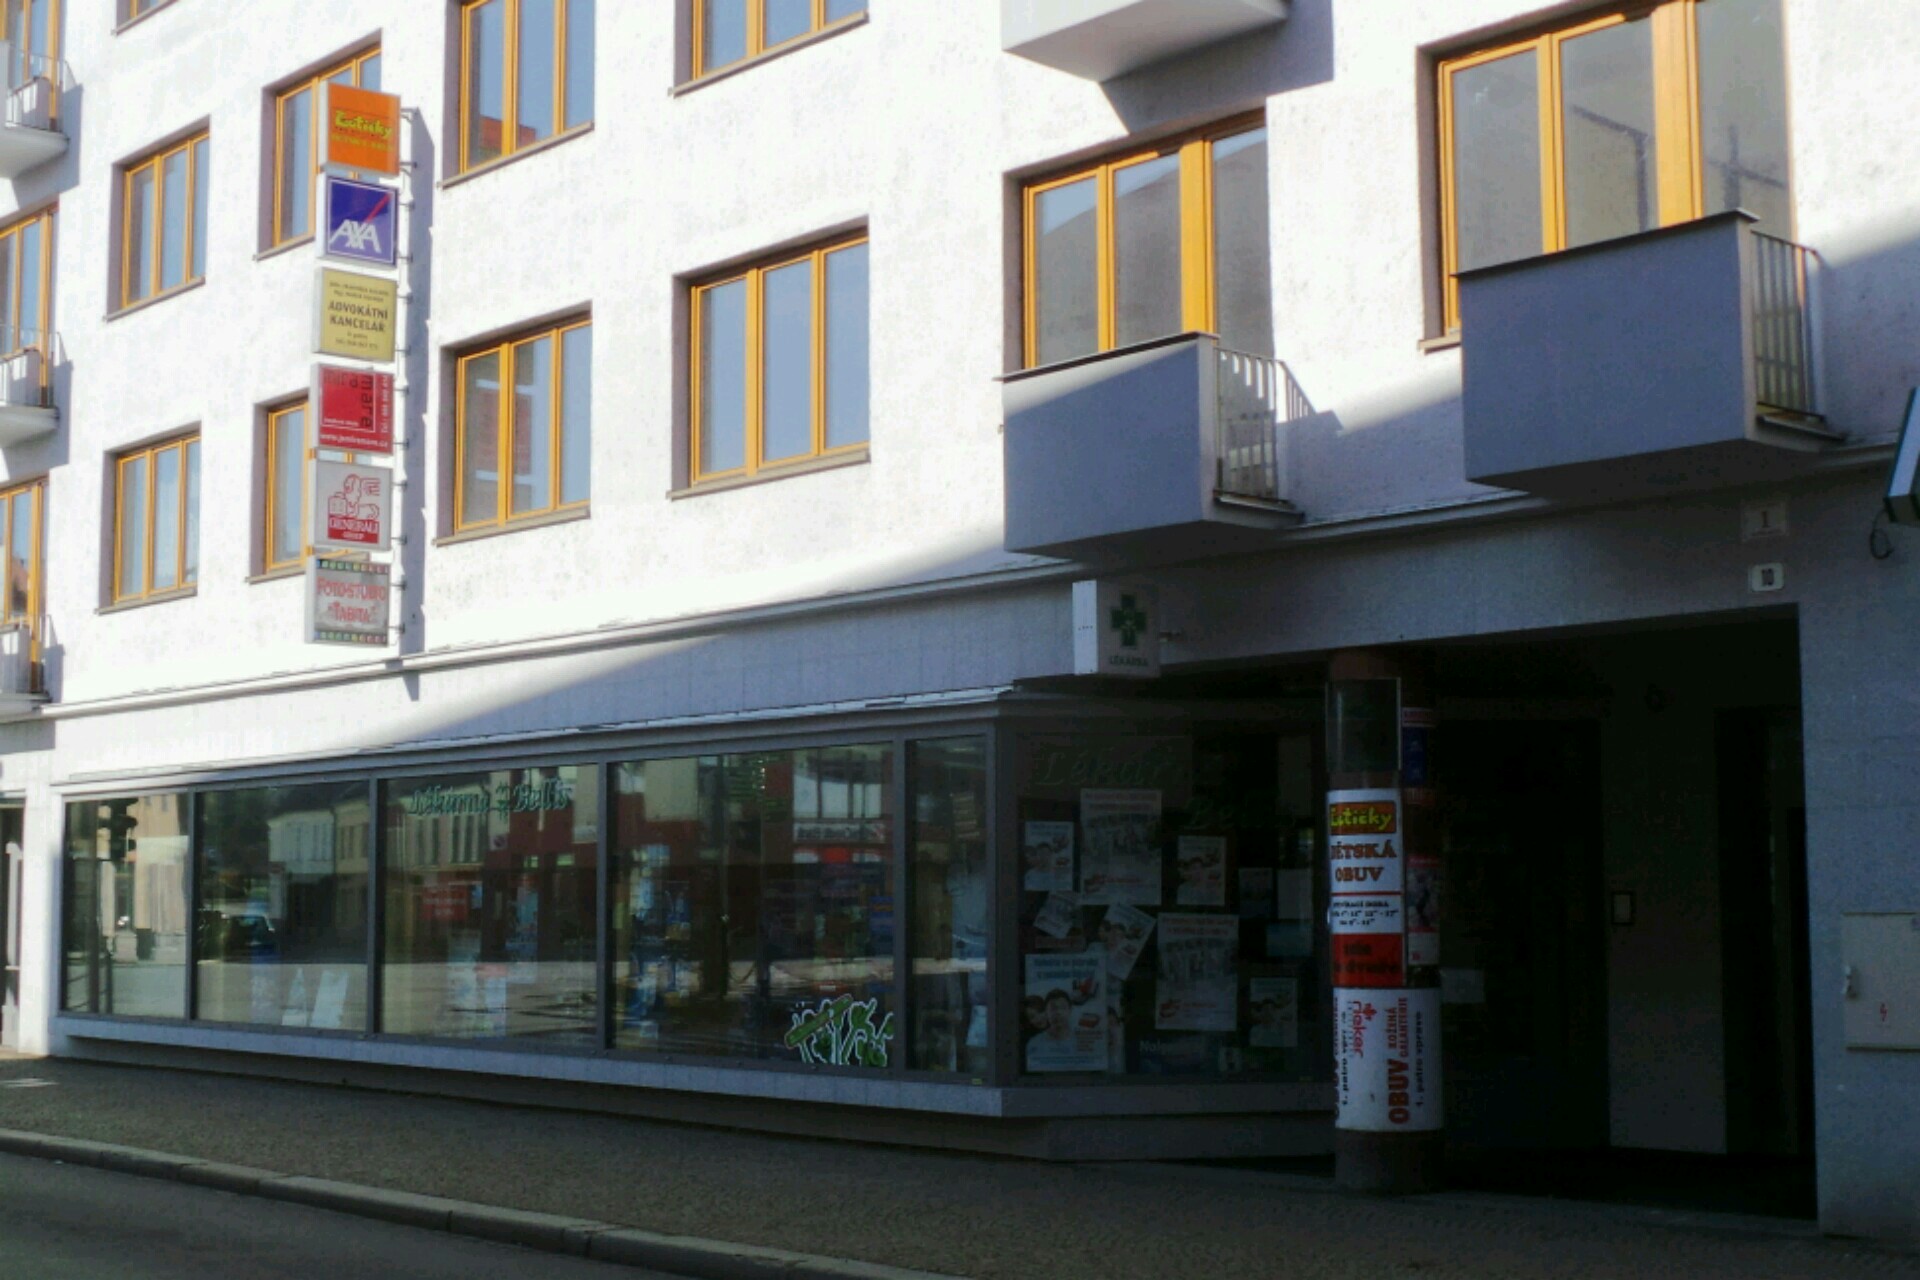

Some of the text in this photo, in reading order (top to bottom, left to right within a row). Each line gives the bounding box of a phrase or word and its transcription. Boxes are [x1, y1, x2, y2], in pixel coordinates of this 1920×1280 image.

[329, 218, 381, 253] AXA
[329, 517, 378, 533] GENERALI
[1335, 866, 1384, 882] OBUV
[1398, 998, 1409, 1058] GALANTERIE
[1415, 1010, 1424, 1054] vpravo
[1387, 1059, 1410, 1124] OBUV
[1415, 1058, 1425, 1093] patro
